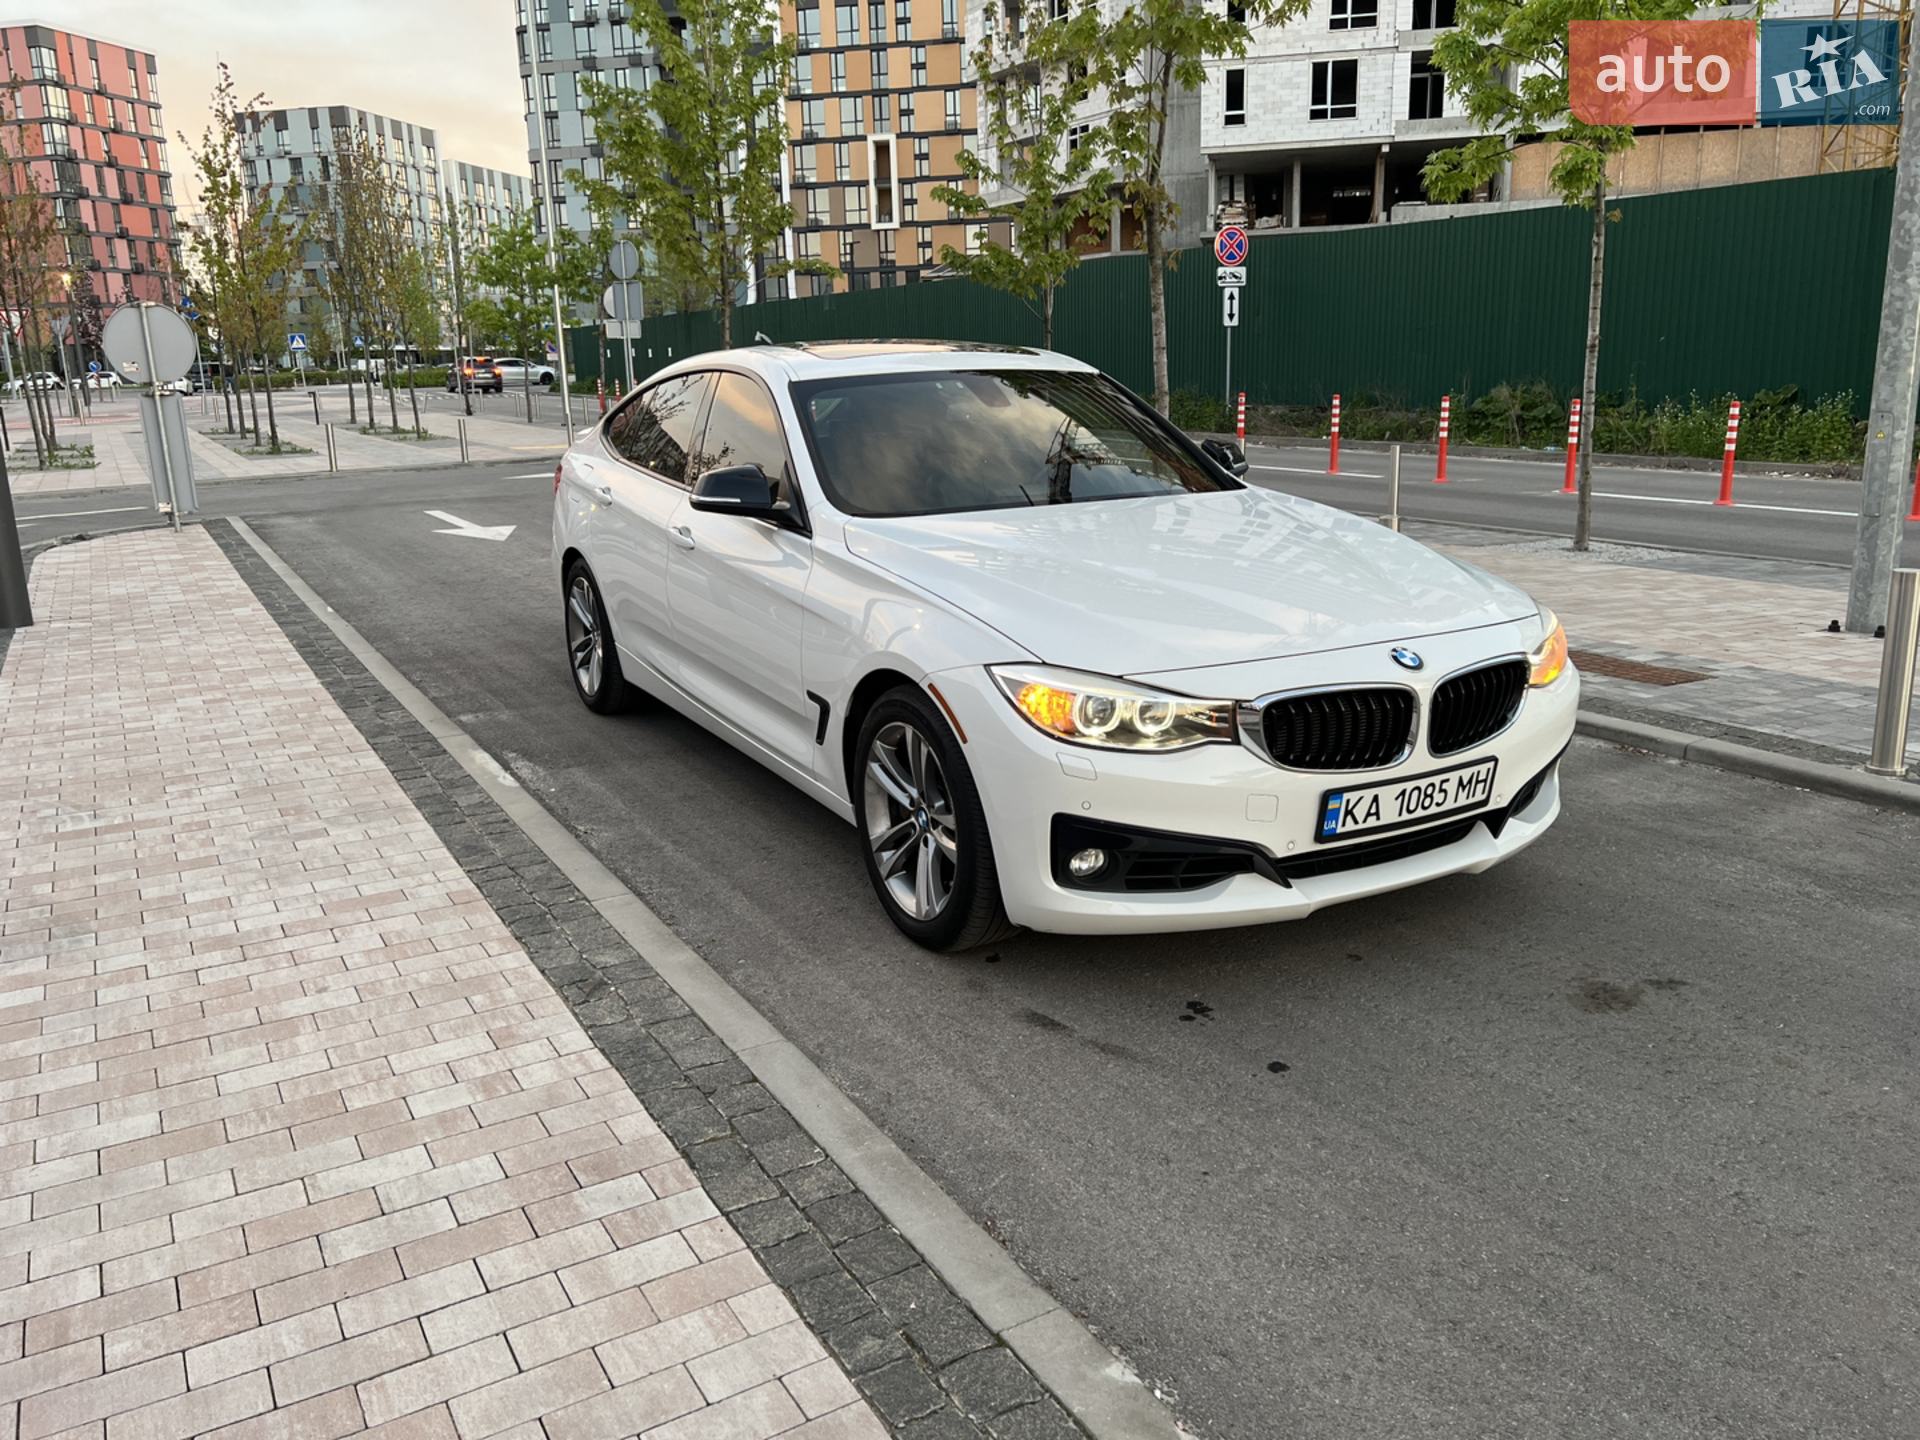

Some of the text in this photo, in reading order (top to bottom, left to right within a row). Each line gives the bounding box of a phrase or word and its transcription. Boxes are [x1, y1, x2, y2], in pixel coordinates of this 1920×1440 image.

[1341, 767, 1491, 828] KA 1085 MH
[1324, 819, 1337, 830] UA
